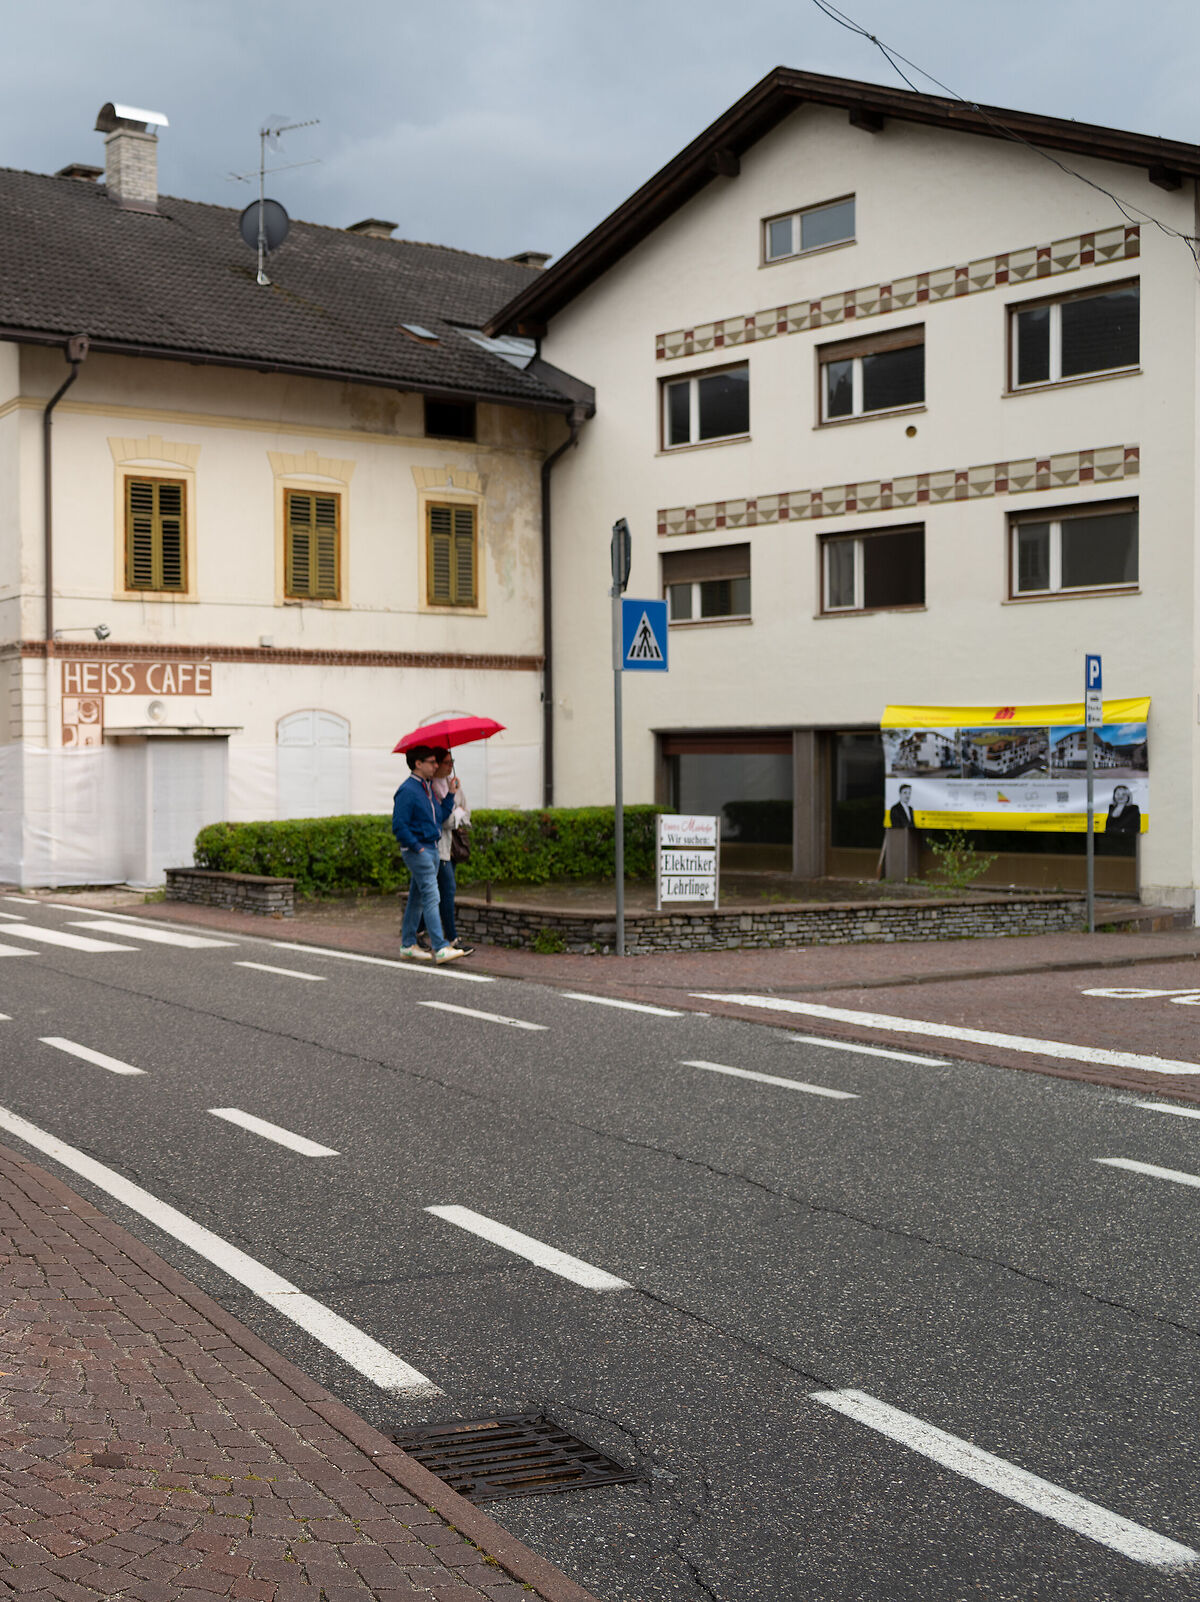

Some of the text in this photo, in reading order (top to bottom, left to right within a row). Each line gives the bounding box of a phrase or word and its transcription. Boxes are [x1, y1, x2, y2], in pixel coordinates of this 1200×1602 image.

[64, 663, 136, 694] HEISS
[1090, 659, 1100, 687] P
[664, 854, 713, 872] Elektriker
[667, 878, 710, 898] Lehrlinge
